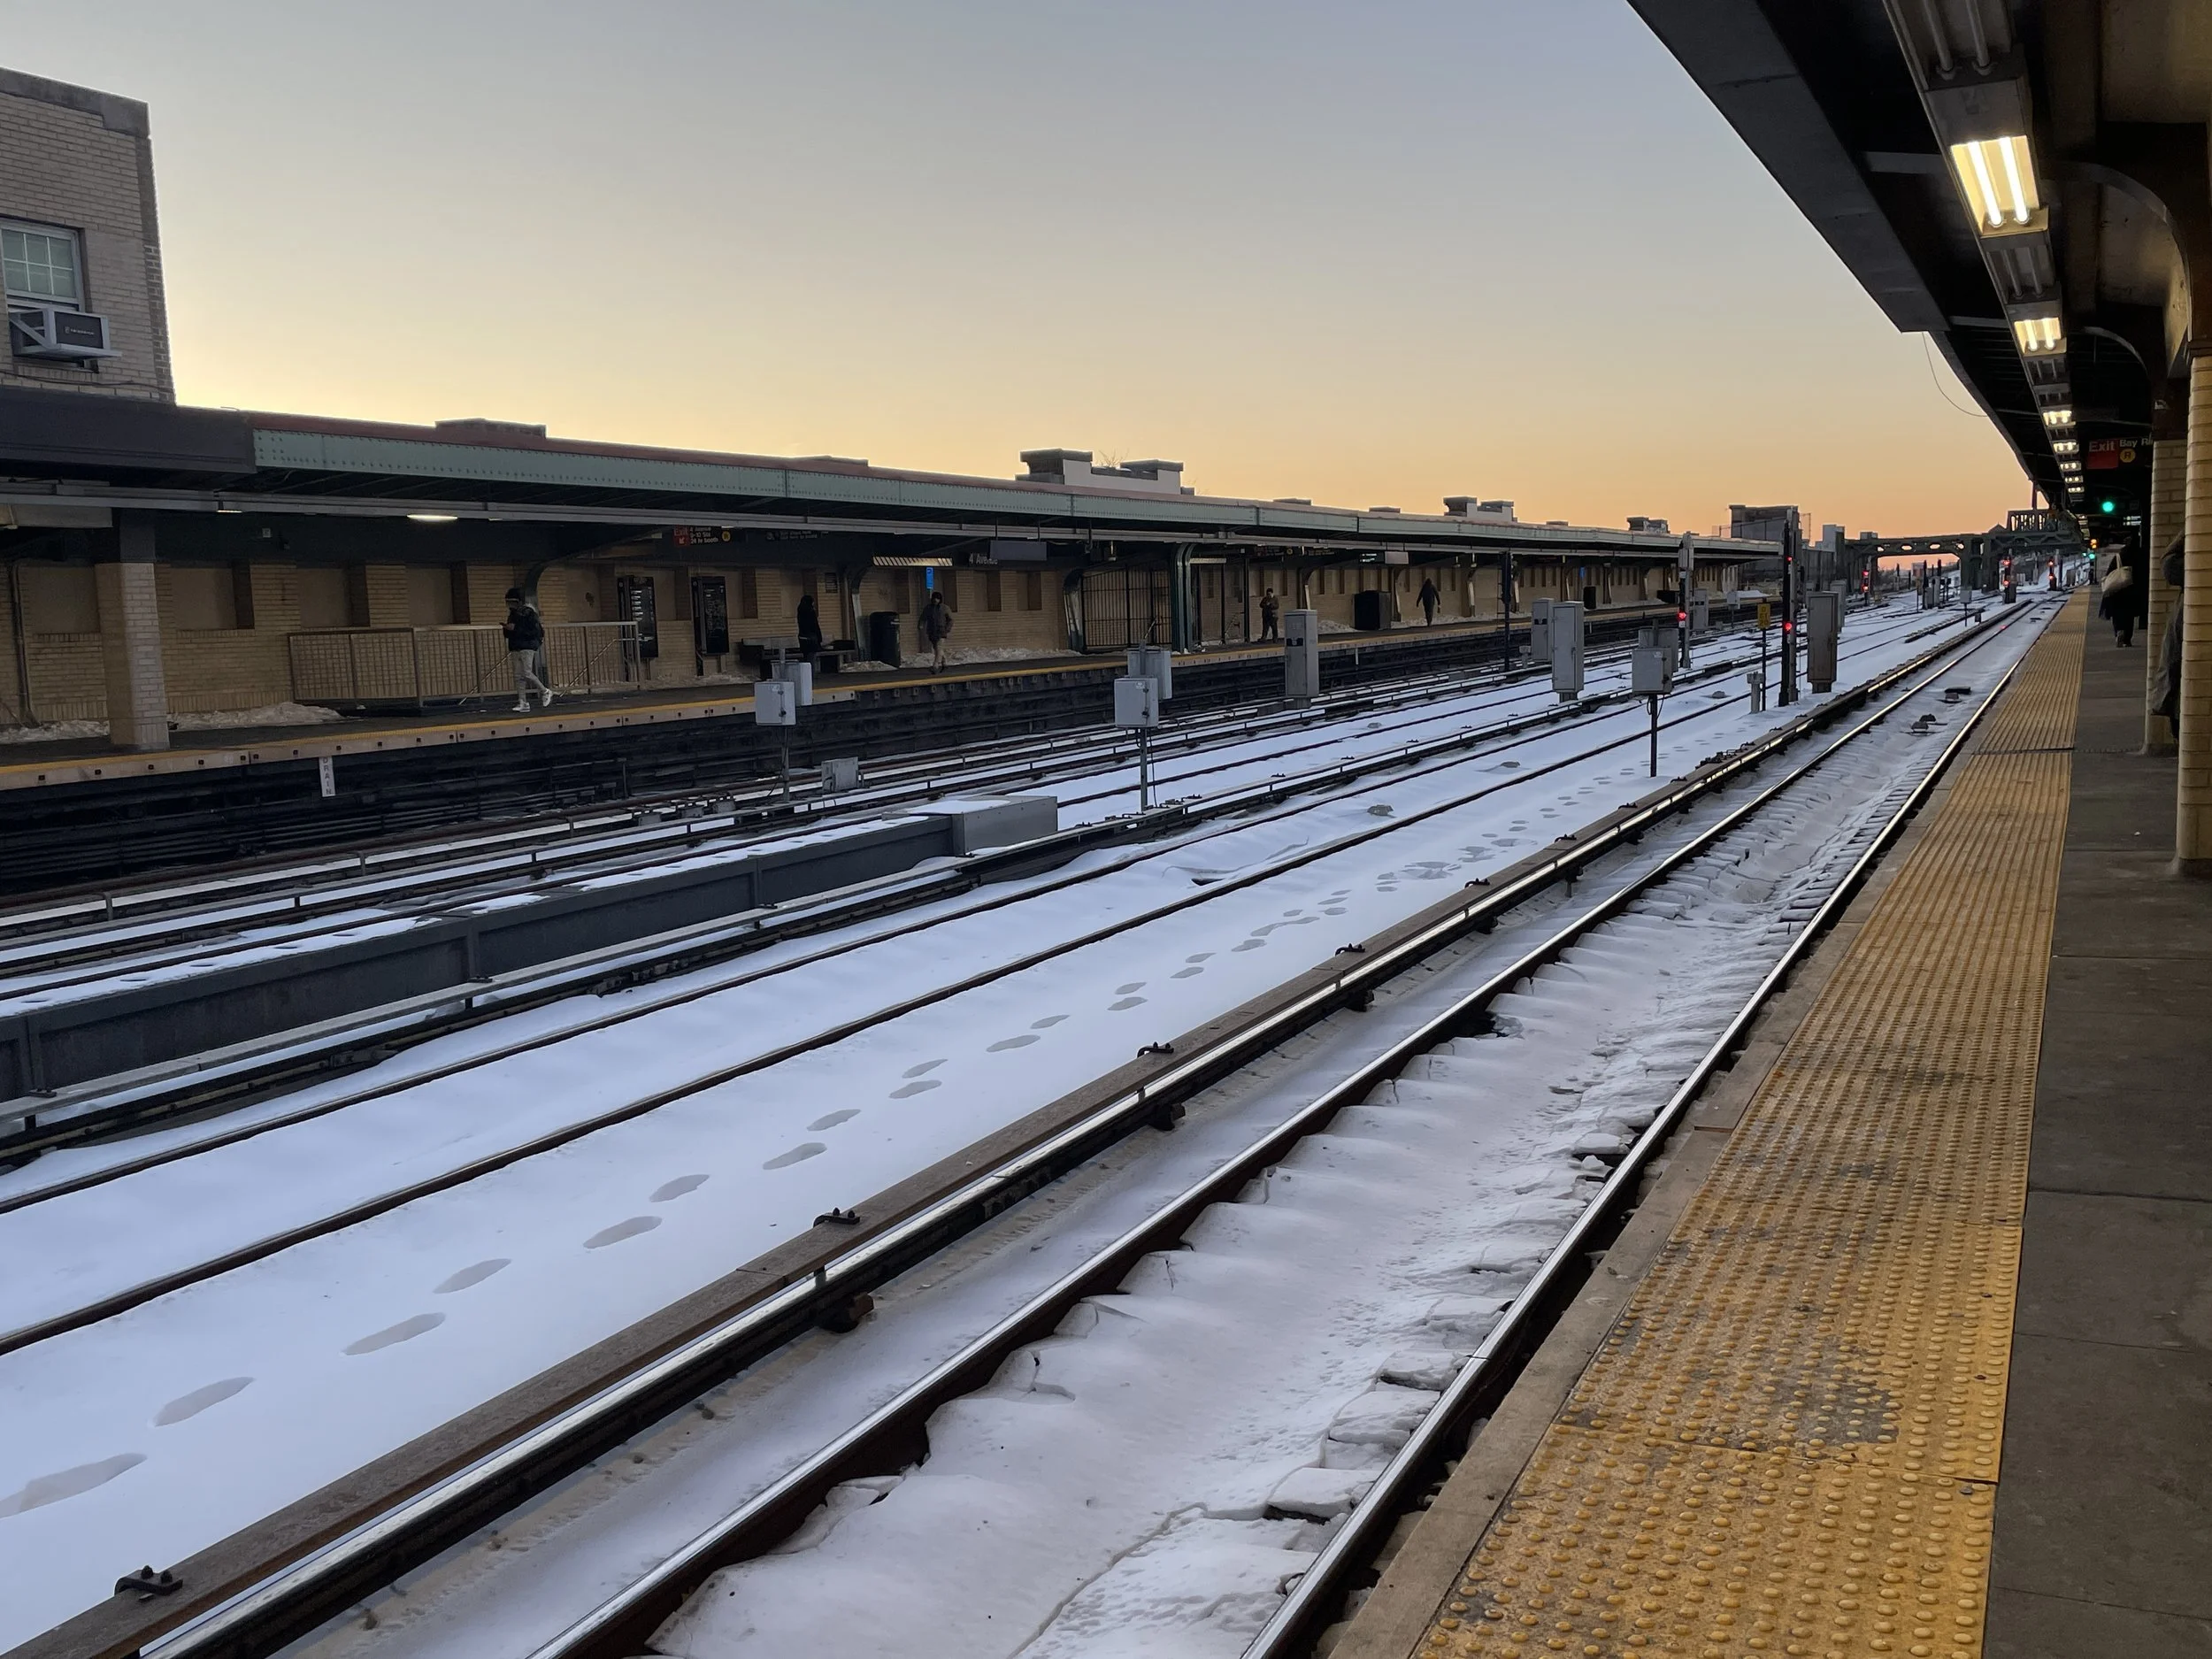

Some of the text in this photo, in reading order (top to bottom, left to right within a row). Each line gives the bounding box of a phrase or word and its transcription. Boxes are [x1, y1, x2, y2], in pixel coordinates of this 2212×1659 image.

[2088, 441, 2115, 452] Exit
[2119, 439, 2138, 448] Bay
[969, 553, 974, 565] 4
